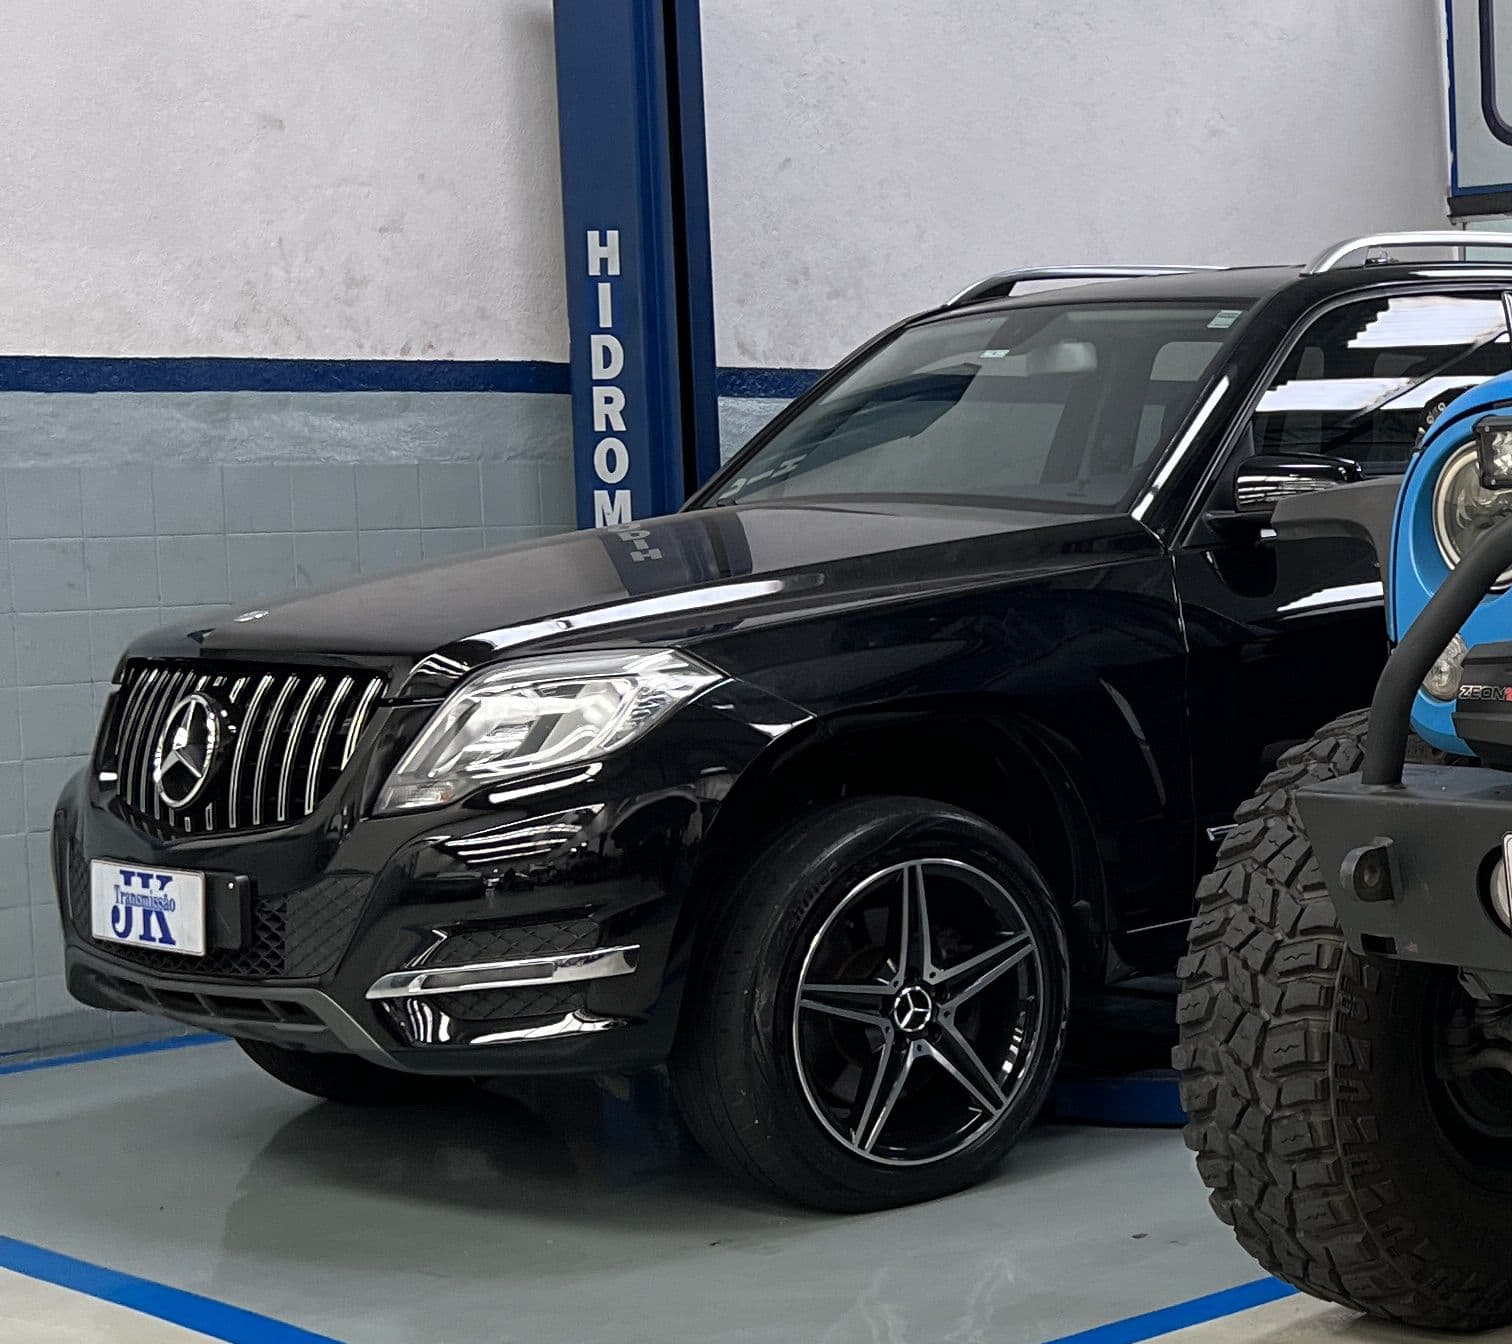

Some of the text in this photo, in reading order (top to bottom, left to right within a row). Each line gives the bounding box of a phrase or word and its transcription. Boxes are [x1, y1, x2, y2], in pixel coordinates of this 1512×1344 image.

[586, 230, 632, 529] HIDROM
[111, 869, 177, 946] JK
[114, 884, 176, 913] Transmissão
